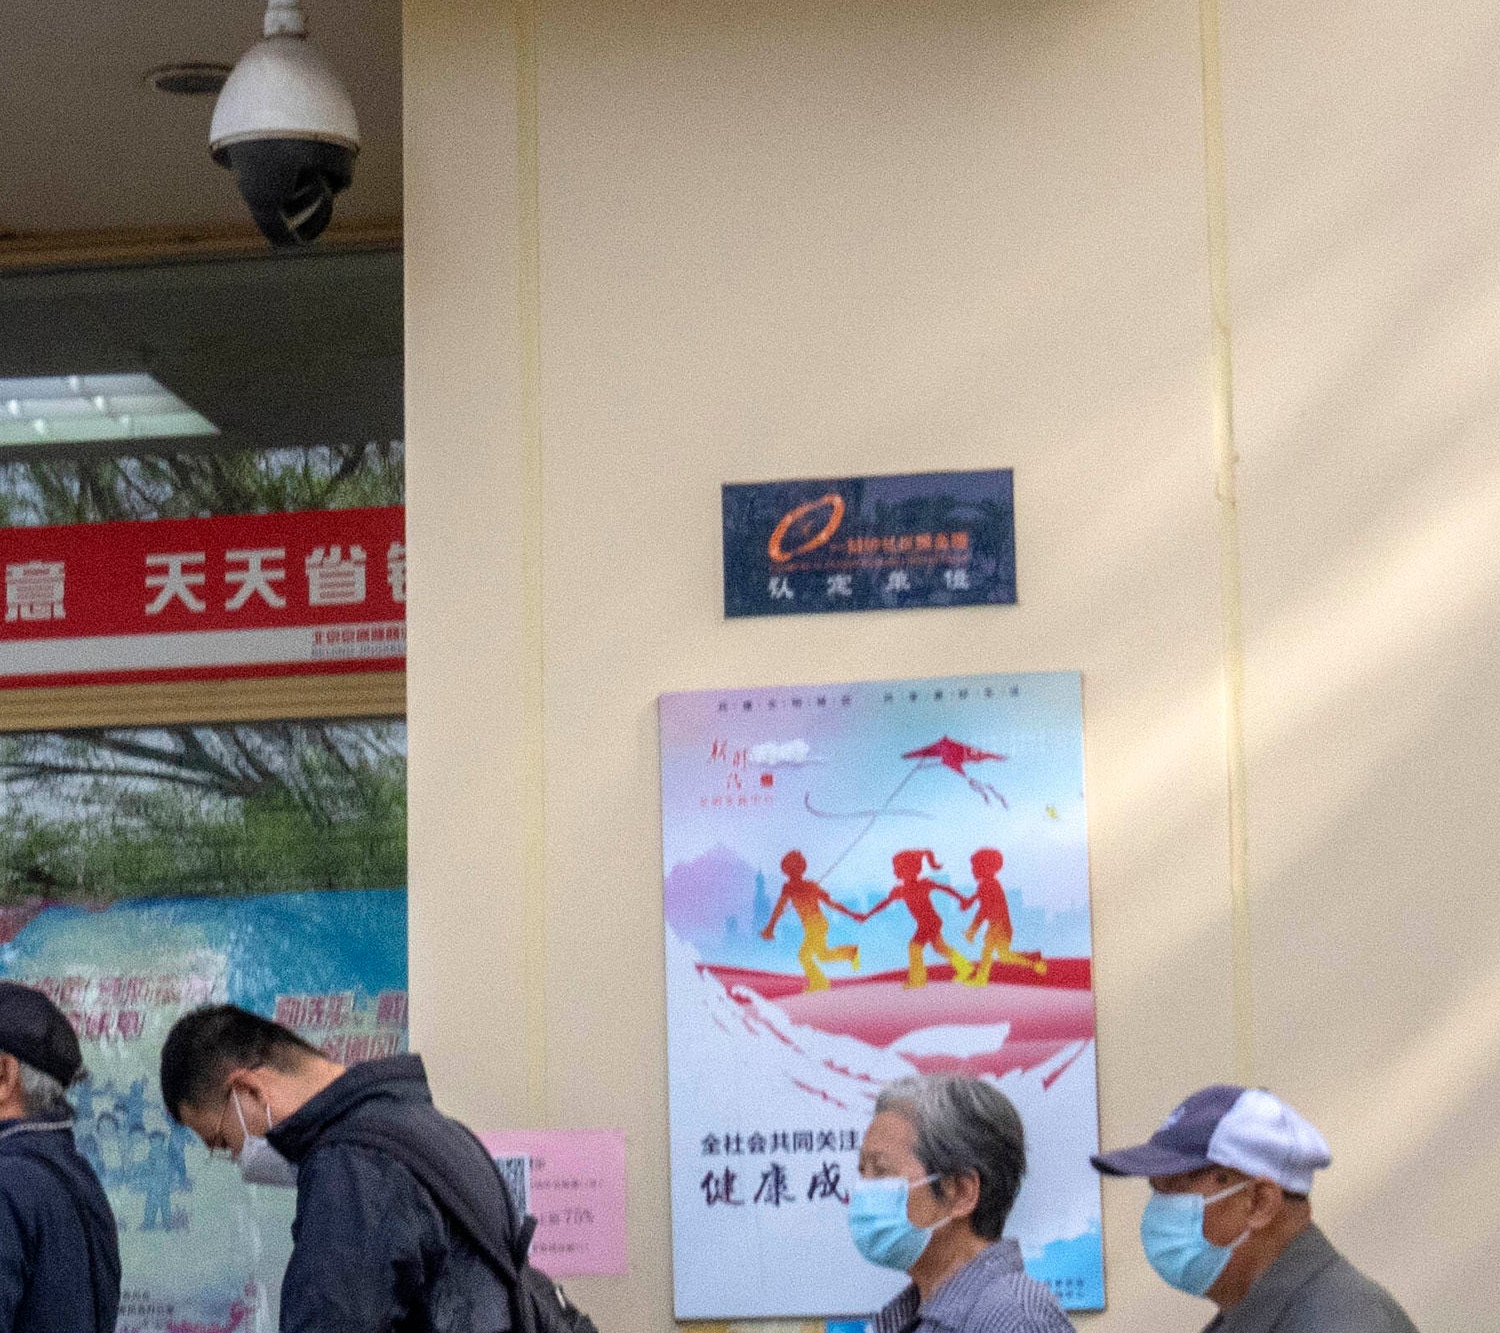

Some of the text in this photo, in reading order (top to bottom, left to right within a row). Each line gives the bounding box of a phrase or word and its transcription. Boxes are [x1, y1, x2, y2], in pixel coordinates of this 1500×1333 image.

[700, 1130, 861, 1156] 全社会共同关注
[700, 1160, 851, 1208] 健康成
